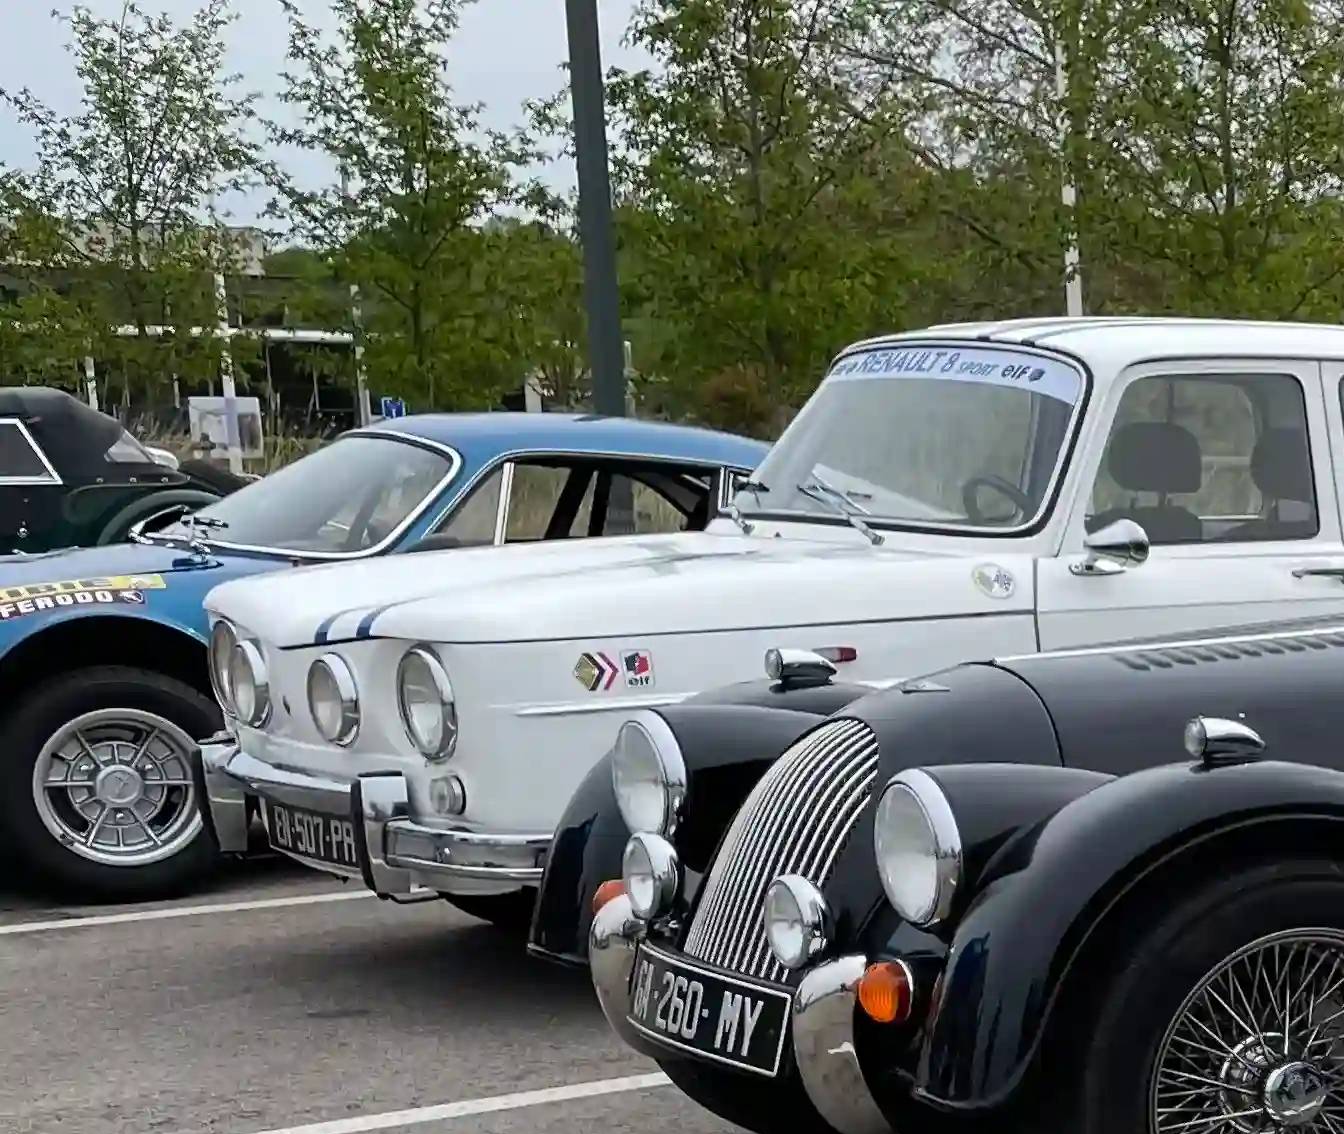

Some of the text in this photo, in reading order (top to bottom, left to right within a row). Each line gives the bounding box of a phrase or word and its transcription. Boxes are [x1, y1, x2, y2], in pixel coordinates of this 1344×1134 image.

[857, 351, 948, 373] RENAULT
[941, 351, 960, 373] 8
[1001, 364, 1031, 381] elf
[0, 590, 114, 618] FERODO
